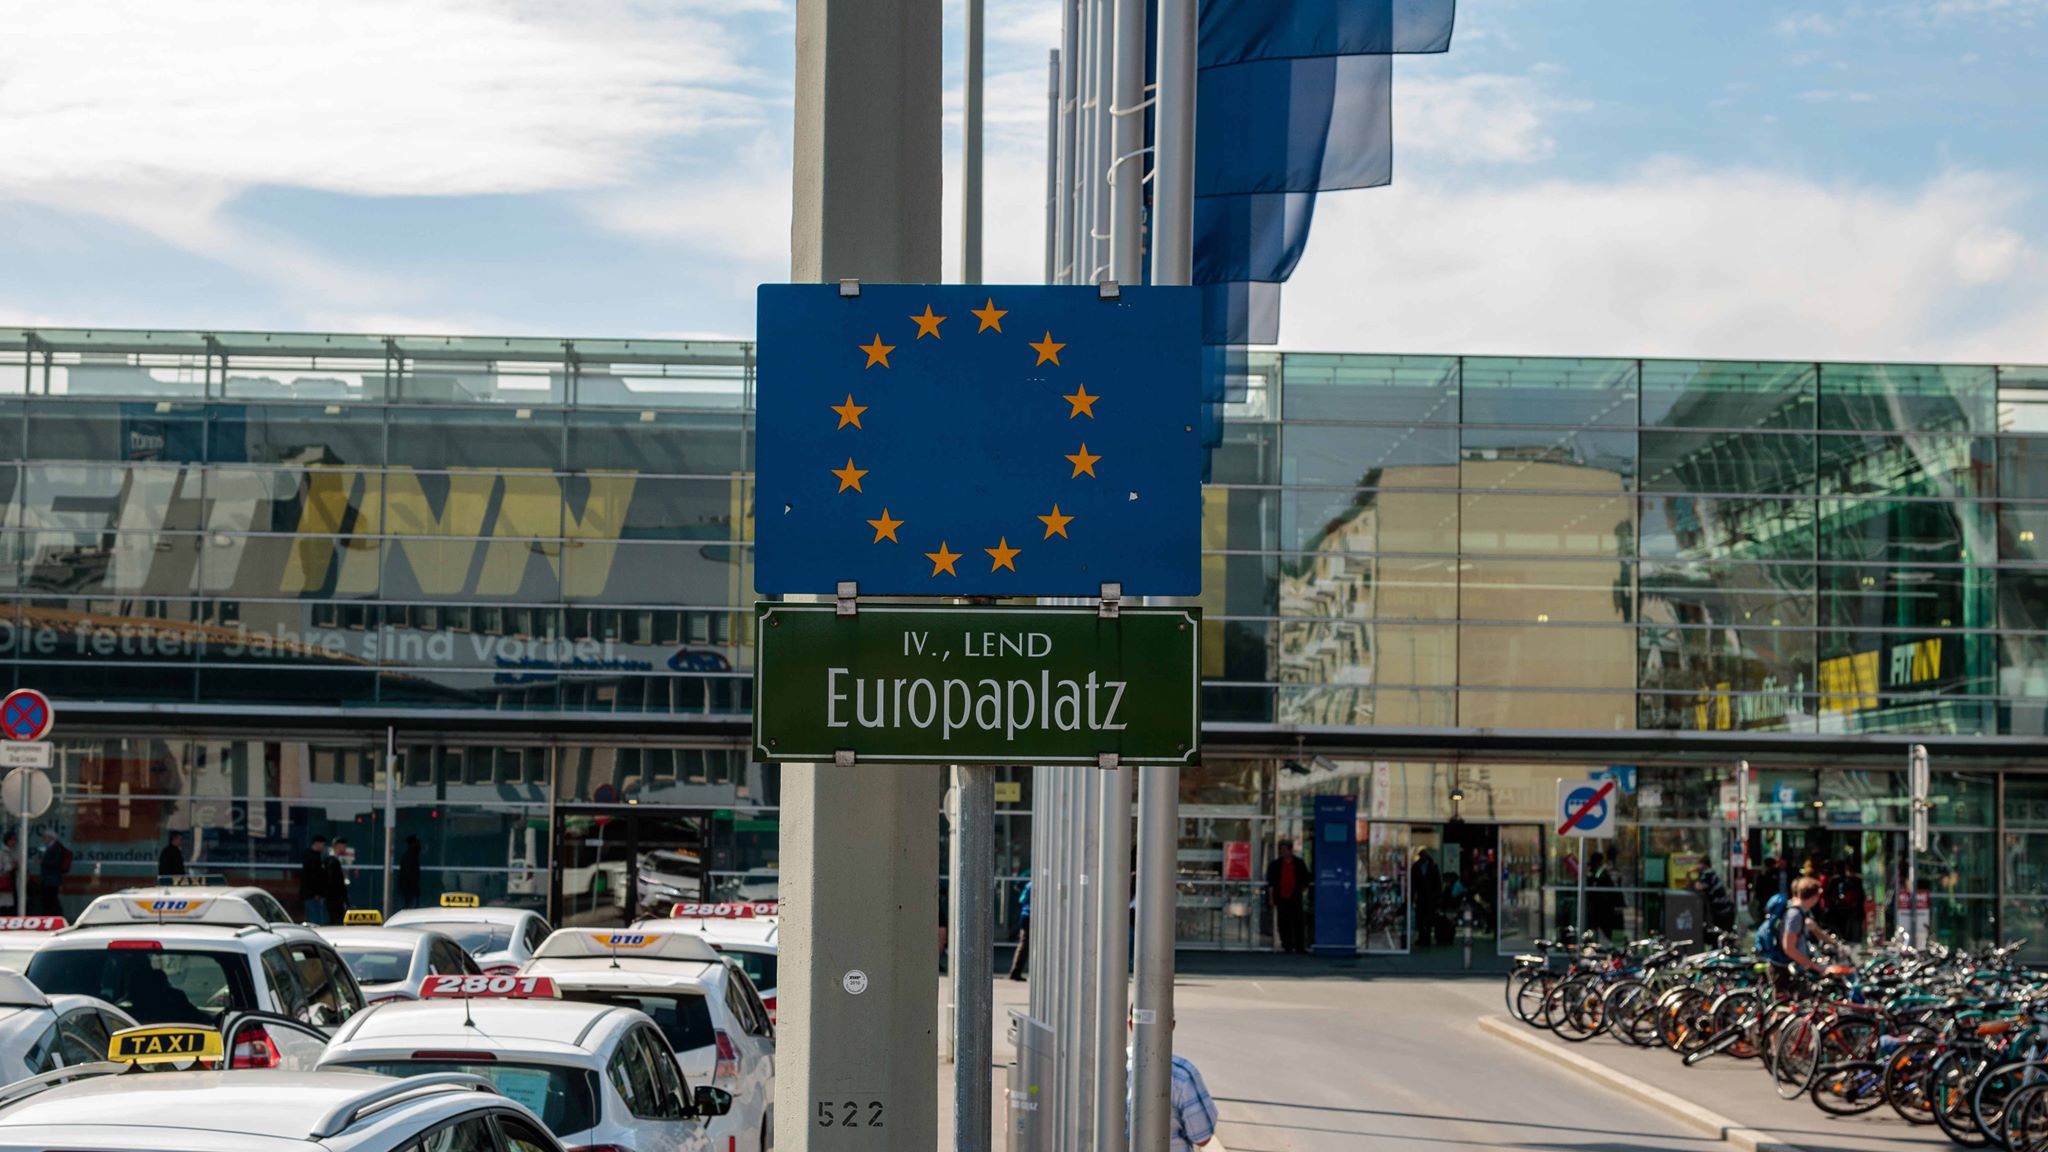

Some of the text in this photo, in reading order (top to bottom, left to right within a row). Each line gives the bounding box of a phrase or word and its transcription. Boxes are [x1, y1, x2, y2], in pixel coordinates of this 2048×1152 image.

[0, 618, 59, 653] Die
[75, 618, 208, 657] fetten
[224, 621, 346, 659] Jahre
[362, 624, 454, 662] sind
[471, 626, 628, 664] vorbei.
[903, 631, 1053, 662] IV., LEND
[827, 666, 1129, 741] Europaplatz
[449, 895, 473, 904] TAXI
[681, 903, 745, 916] 2801
[349, 912, 377, 922] TAXI
[433, 975, 540, 994] 2801
[131, 1034, 194, 1055] TAXI
[818, 1100, 884, 1128] 522
